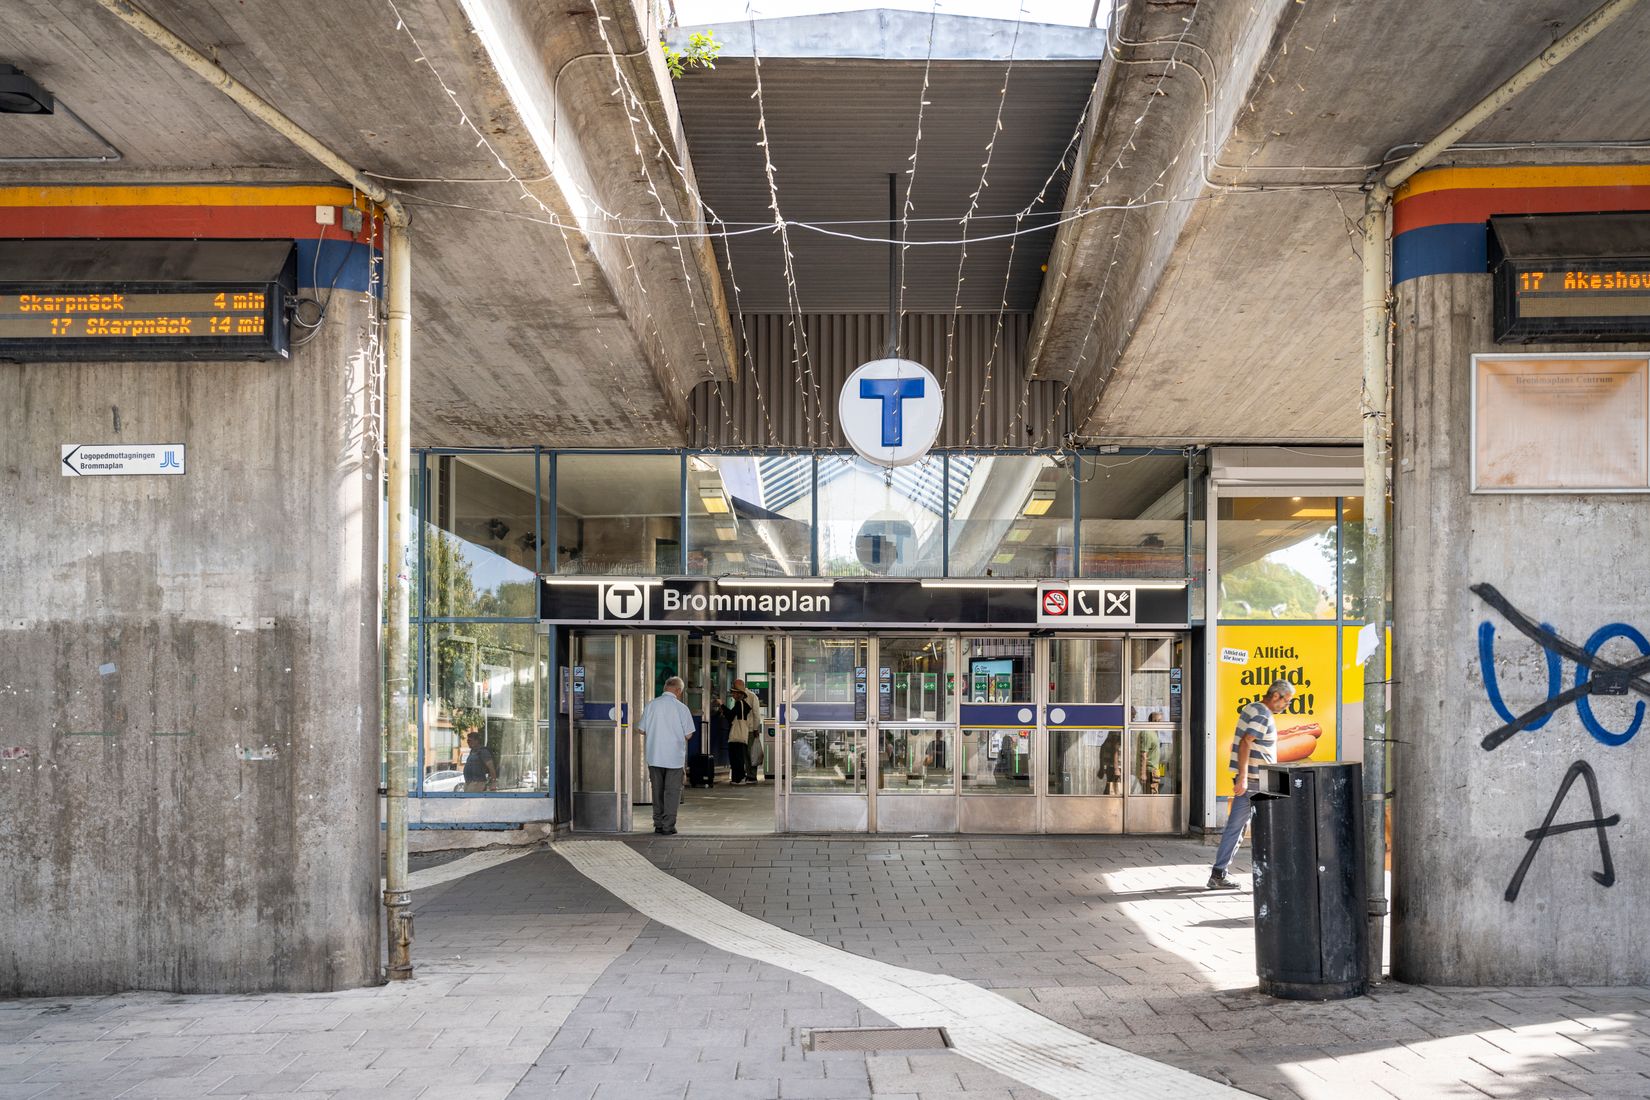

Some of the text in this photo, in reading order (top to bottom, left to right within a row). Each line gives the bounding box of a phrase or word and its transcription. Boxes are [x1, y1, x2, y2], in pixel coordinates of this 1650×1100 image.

[1520, 272, 1544, 290] 17
[19, 292, 265, 313] Skarpnäck 4 min
[50, 318, 72, 335] 17
[86, 316, 192, 337] Skarpnäck
[209, 316, 231, 333] 14
[859, 377, 926, 448] T
[80, 452, 156, 463] Logopedmottagningen
[80, 462, 124, 471] Brommaplan
[613, 588, 832, 616] T Brommaplan
[1253, 645, 1299, 660] Alltid,
